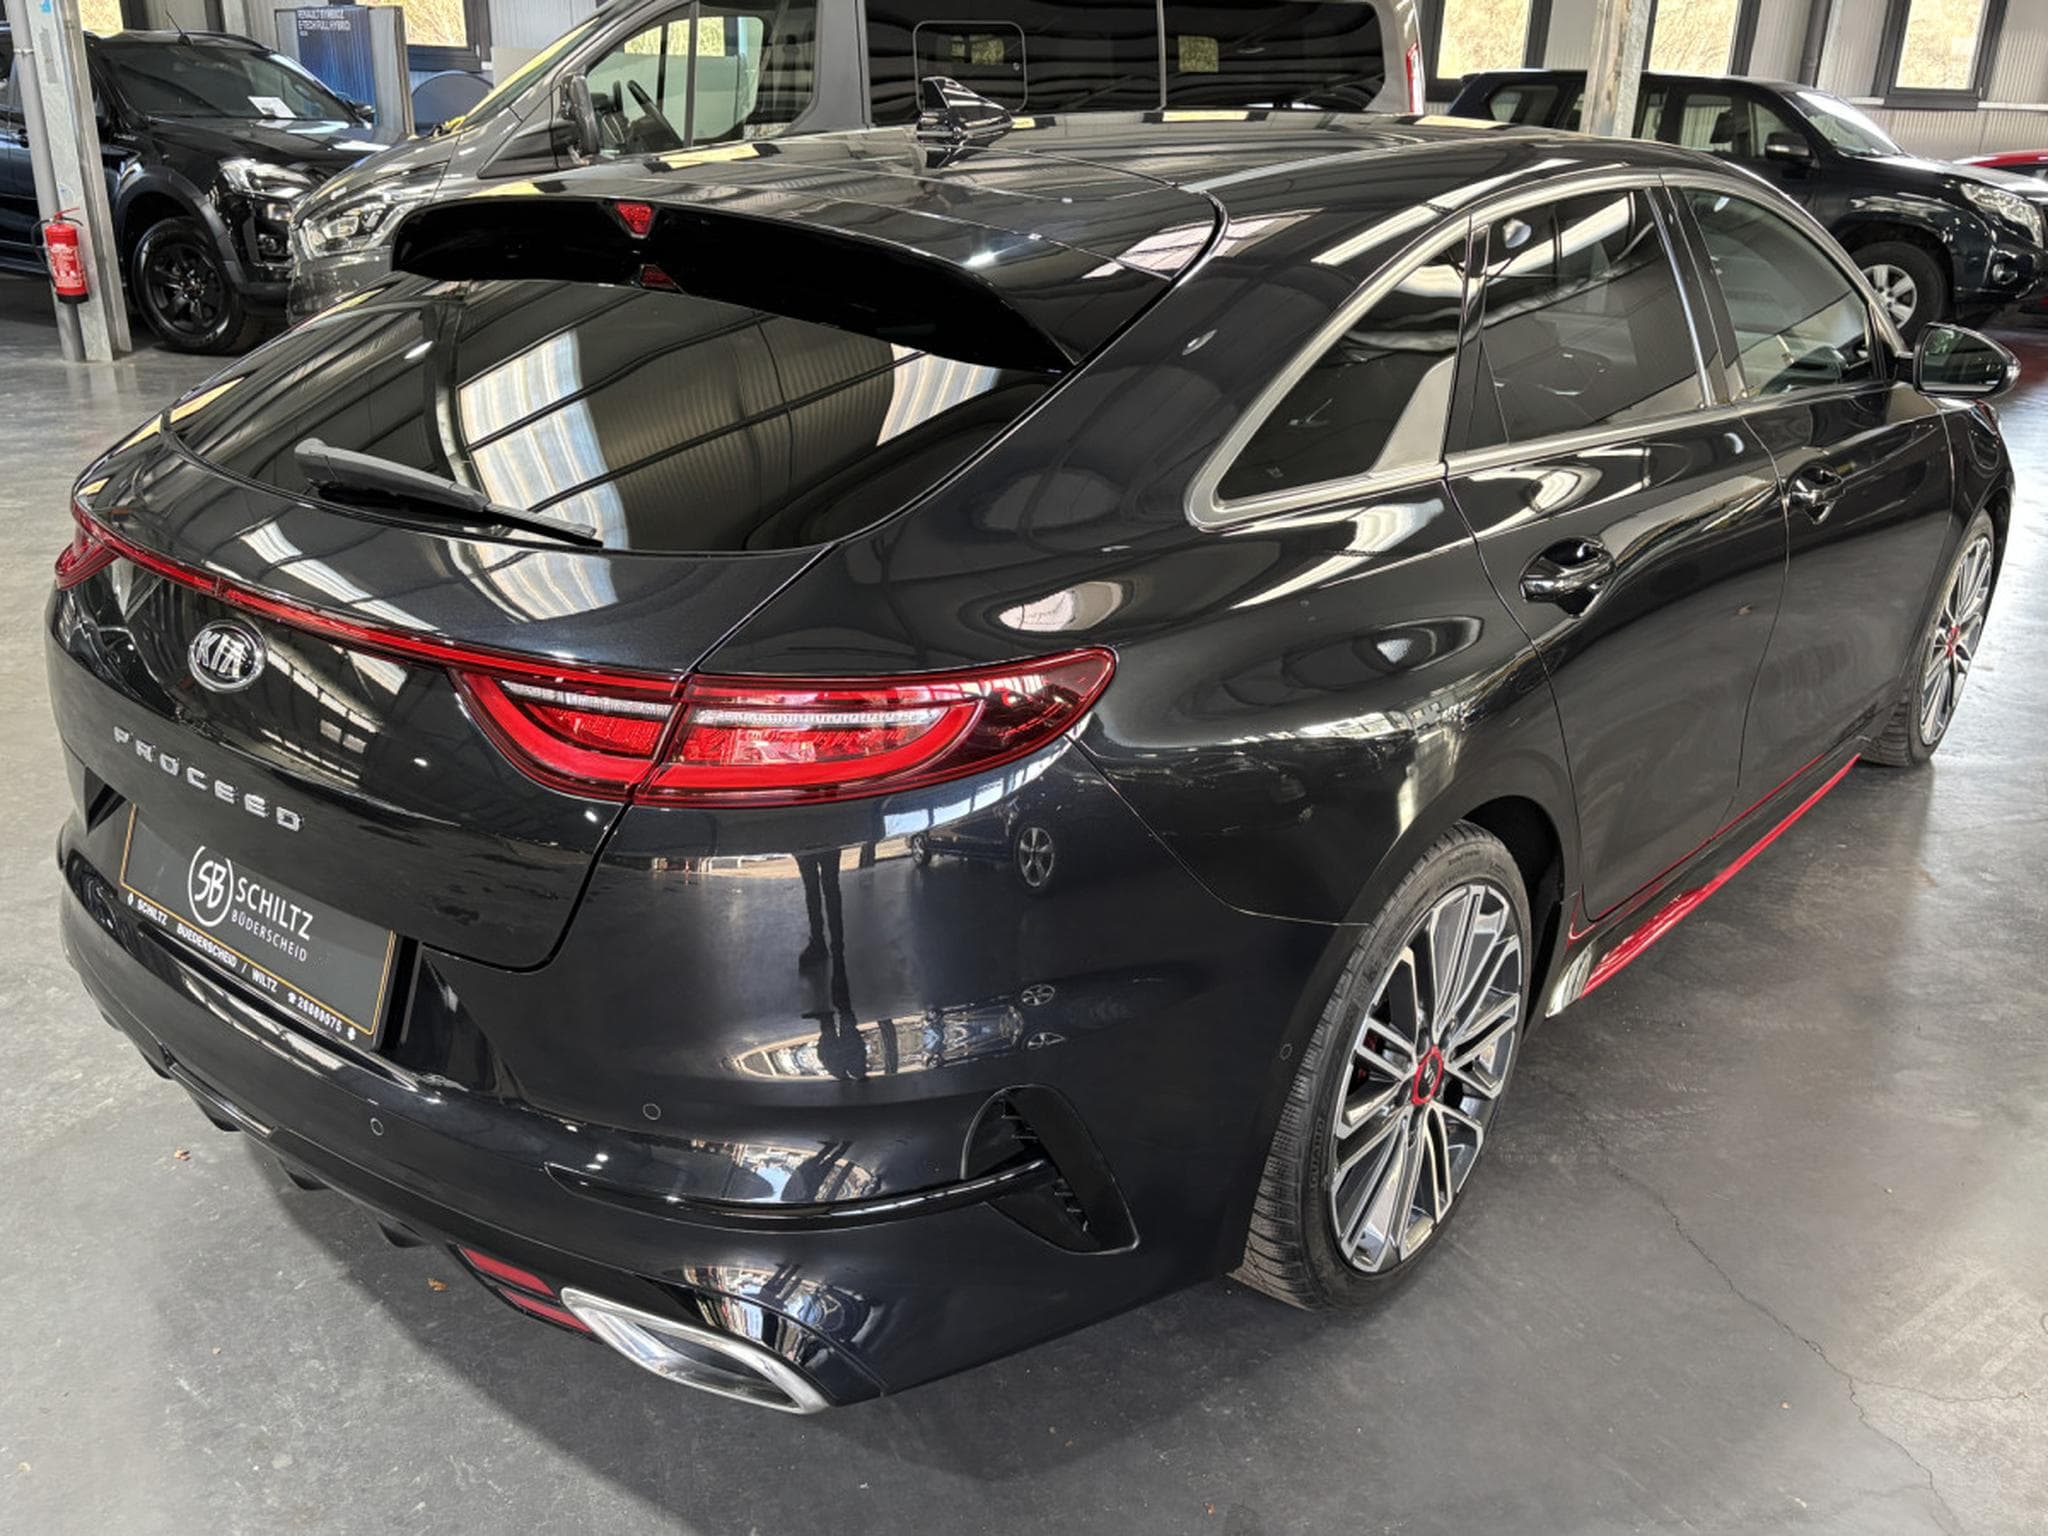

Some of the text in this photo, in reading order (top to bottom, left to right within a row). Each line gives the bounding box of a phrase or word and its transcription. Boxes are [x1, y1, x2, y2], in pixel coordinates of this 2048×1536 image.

[196, 631, 247, 678] KIA
[113, 726, 302, 831] PROCEED
[231, 909, 307, 962] BÜDERSCHEID
[235, 877, 313, 941] SCHILTZ
[137, 899, 168, 926] SCHILTZ
[252, 968, 278, 992] WILTZ
